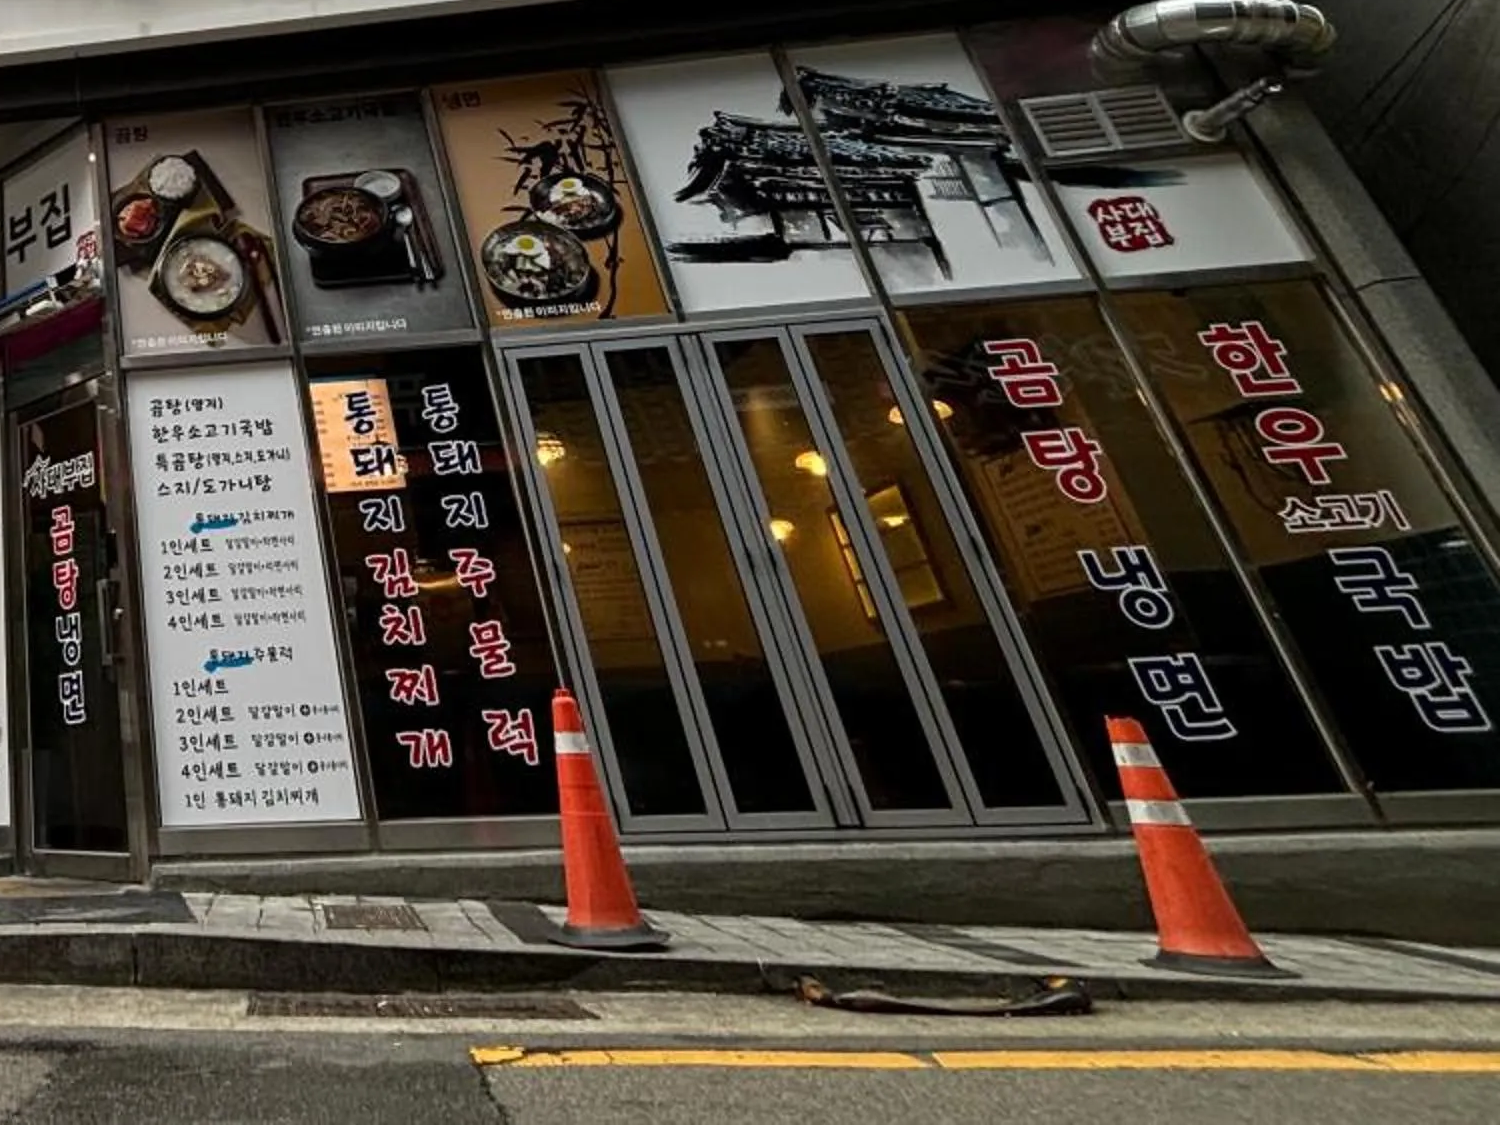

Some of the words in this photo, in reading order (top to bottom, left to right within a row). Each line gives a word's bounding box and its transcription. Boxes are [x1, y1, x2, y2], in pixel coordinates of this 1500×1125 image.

[1095, 199, 1160, 225] 사대
[1107, 220, 1168, 249] 부집
[1197, 320, 1350, 486] 한우
[152, 418, 273, 443] 한우소고기국밥
[344, 390, 405, 532] 통돼지
[421, 382, 489, 529] 통돼지
[26, 451, 95, 499] 사대부집
[1277, 489, 1410, 534] 소고기
[161, 538, 213, 556] 1인세트
[984, 338, 1108, 505] 곰탕
[1078, 545, 1238, 741] 냉면
[50, 505, 79, 610] 곰탕
[163, 562, 219, 580] 2인세트
[166, 587, 222, 605] 3인세트
[168, 612, 225, 631] 4인세트
[1329, 546, 1494, 733] 국밥
[56, 612, 86, 725] 냉면
[365, 547, 453, 768] 김치찌개
[448, 548, 540, 766] 주물럭
[173, 679, 228, 697] 1인세트
[176, 706, 235, 725] 2인세트
[179, 733, 238, 753] 3인세트
[181, 761, 242, 782] 4인세트
[185, 789, 205, 809] 1인
